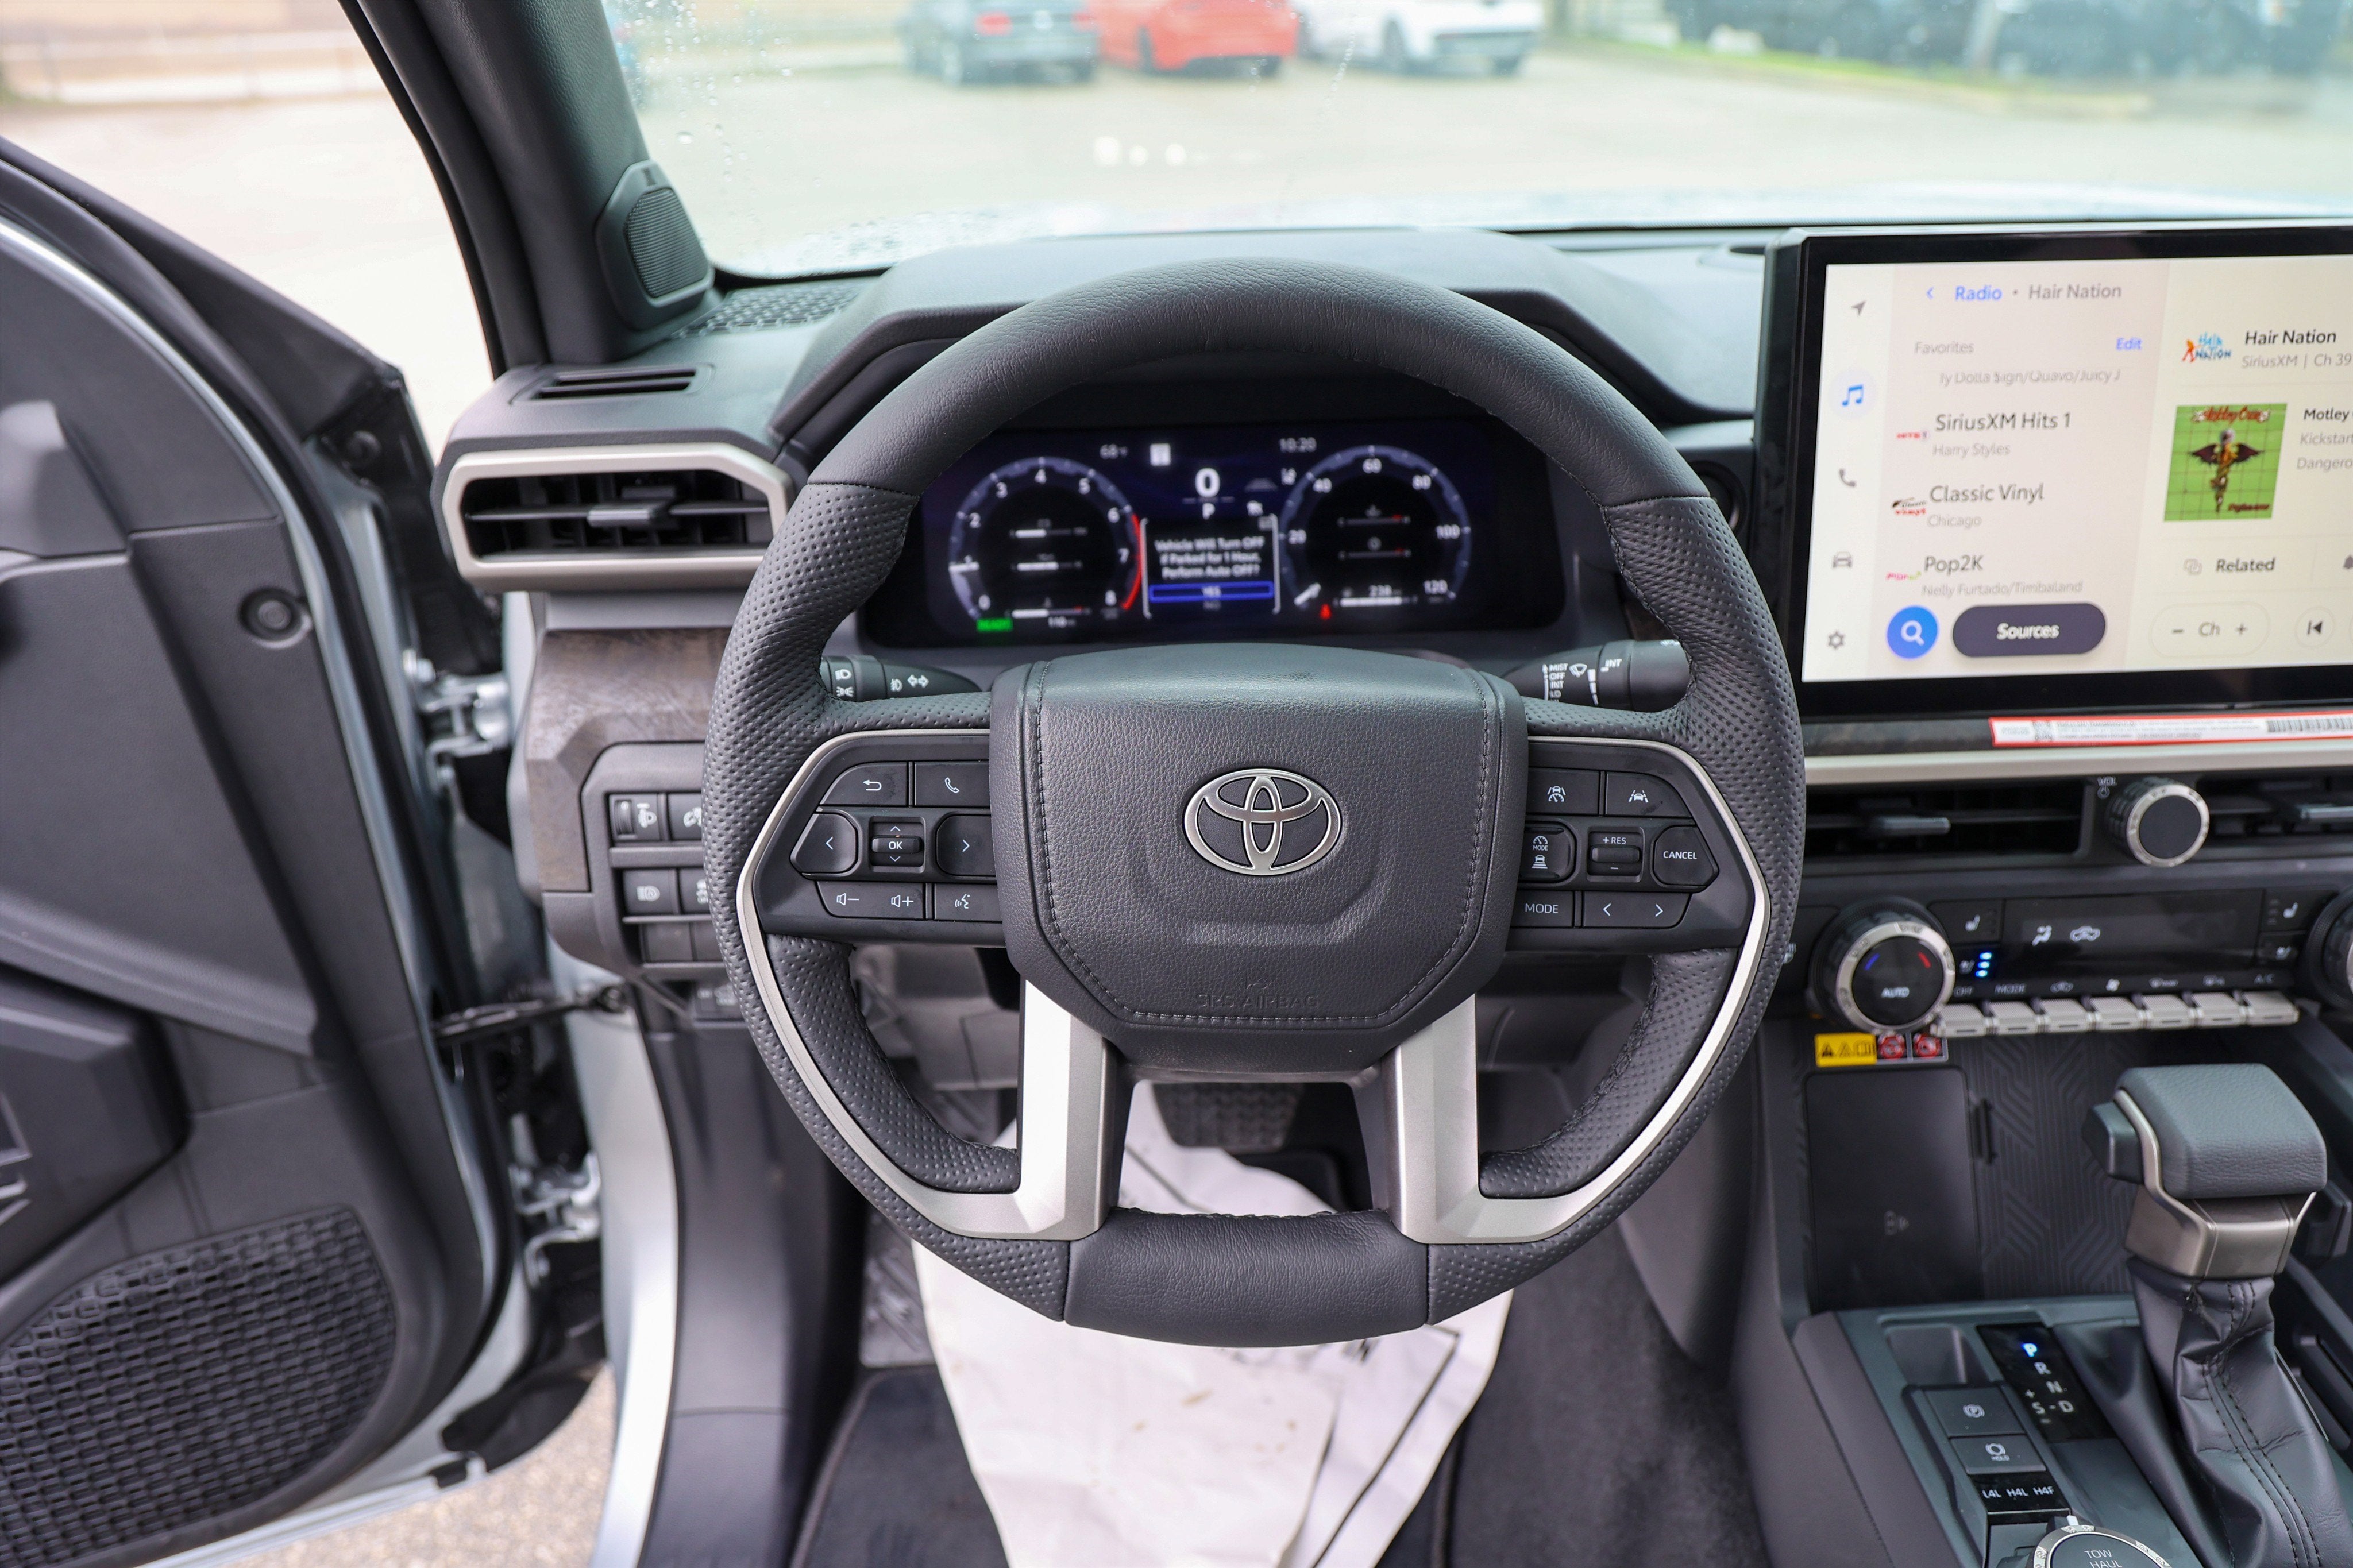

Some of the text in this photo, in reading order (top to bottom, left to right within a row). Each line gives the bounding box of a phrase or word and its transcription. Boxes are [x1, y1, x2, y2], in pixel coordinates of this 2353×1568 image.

[1955, 282, 2123, 302] Radio Hair Nation
[2116, 338, 2143, 350] Edit
[2245, 329, 2337, 345] Hair Nation
[1914, 341, 1974, 354] Favorites
[2242, 353, 2352, 369] SiriusXM Ch 39
[1935, 412, 2071, 431] SiriusXM Hits 1
[2304, 406, 2350, 423] Motley
[1932, 442, 2011, 458] Harry Styles
[1035, 468, 1047, 485] 4
[1194, 467, 1221, 498] 0
[996, 481, 1008, 499] 3
[1078, 478, 1090, 495] 5
[1929, 483, 2044, 503] Classic Vinyl
[969, 512, 981, 528] 2
[1107, 507, 1120, 523] 6
[1927, 514, 1982, 529] Chicago
[1118, 547, 1130, 563] 7
[1924, 555, 1984, 574] Pop2K
[2216, 556, 2276, 573] Related
[1921, 581, 2082, 598] Nelly Furtado/Timbaland
[1996, 622, 2060, 640] Sources
[2198, 622, 2220, 637] Ch
[1548, 663, 1568, 672] MIST
[1549, 672, 1565, 681] OFF
[1551, 681, 1564, 689] INT
[1549, 690, 1561, 698] LO
[888, 841, 903, 850] OK
[1663, 851, 1698, 860] CANCEL
[1524, 903, 1559, 914] MODE
[1881, 986, 1910, 998] AUTO
[1243, 993, 1320, 1009] AIRBAG
[2022, 1342, 2038, 1357] P
[2034, 1361, 2052, 1375] R
[2046, 1380, 2063, 1393] N
[2031, 1400, 2074, 1415] S D
[1982, 1486, 2055, 1499] L4L H4L H4F
[2084, 1549, 2112, 1559] TOW
[2089, 1559, 2123, 1568] HAUL
